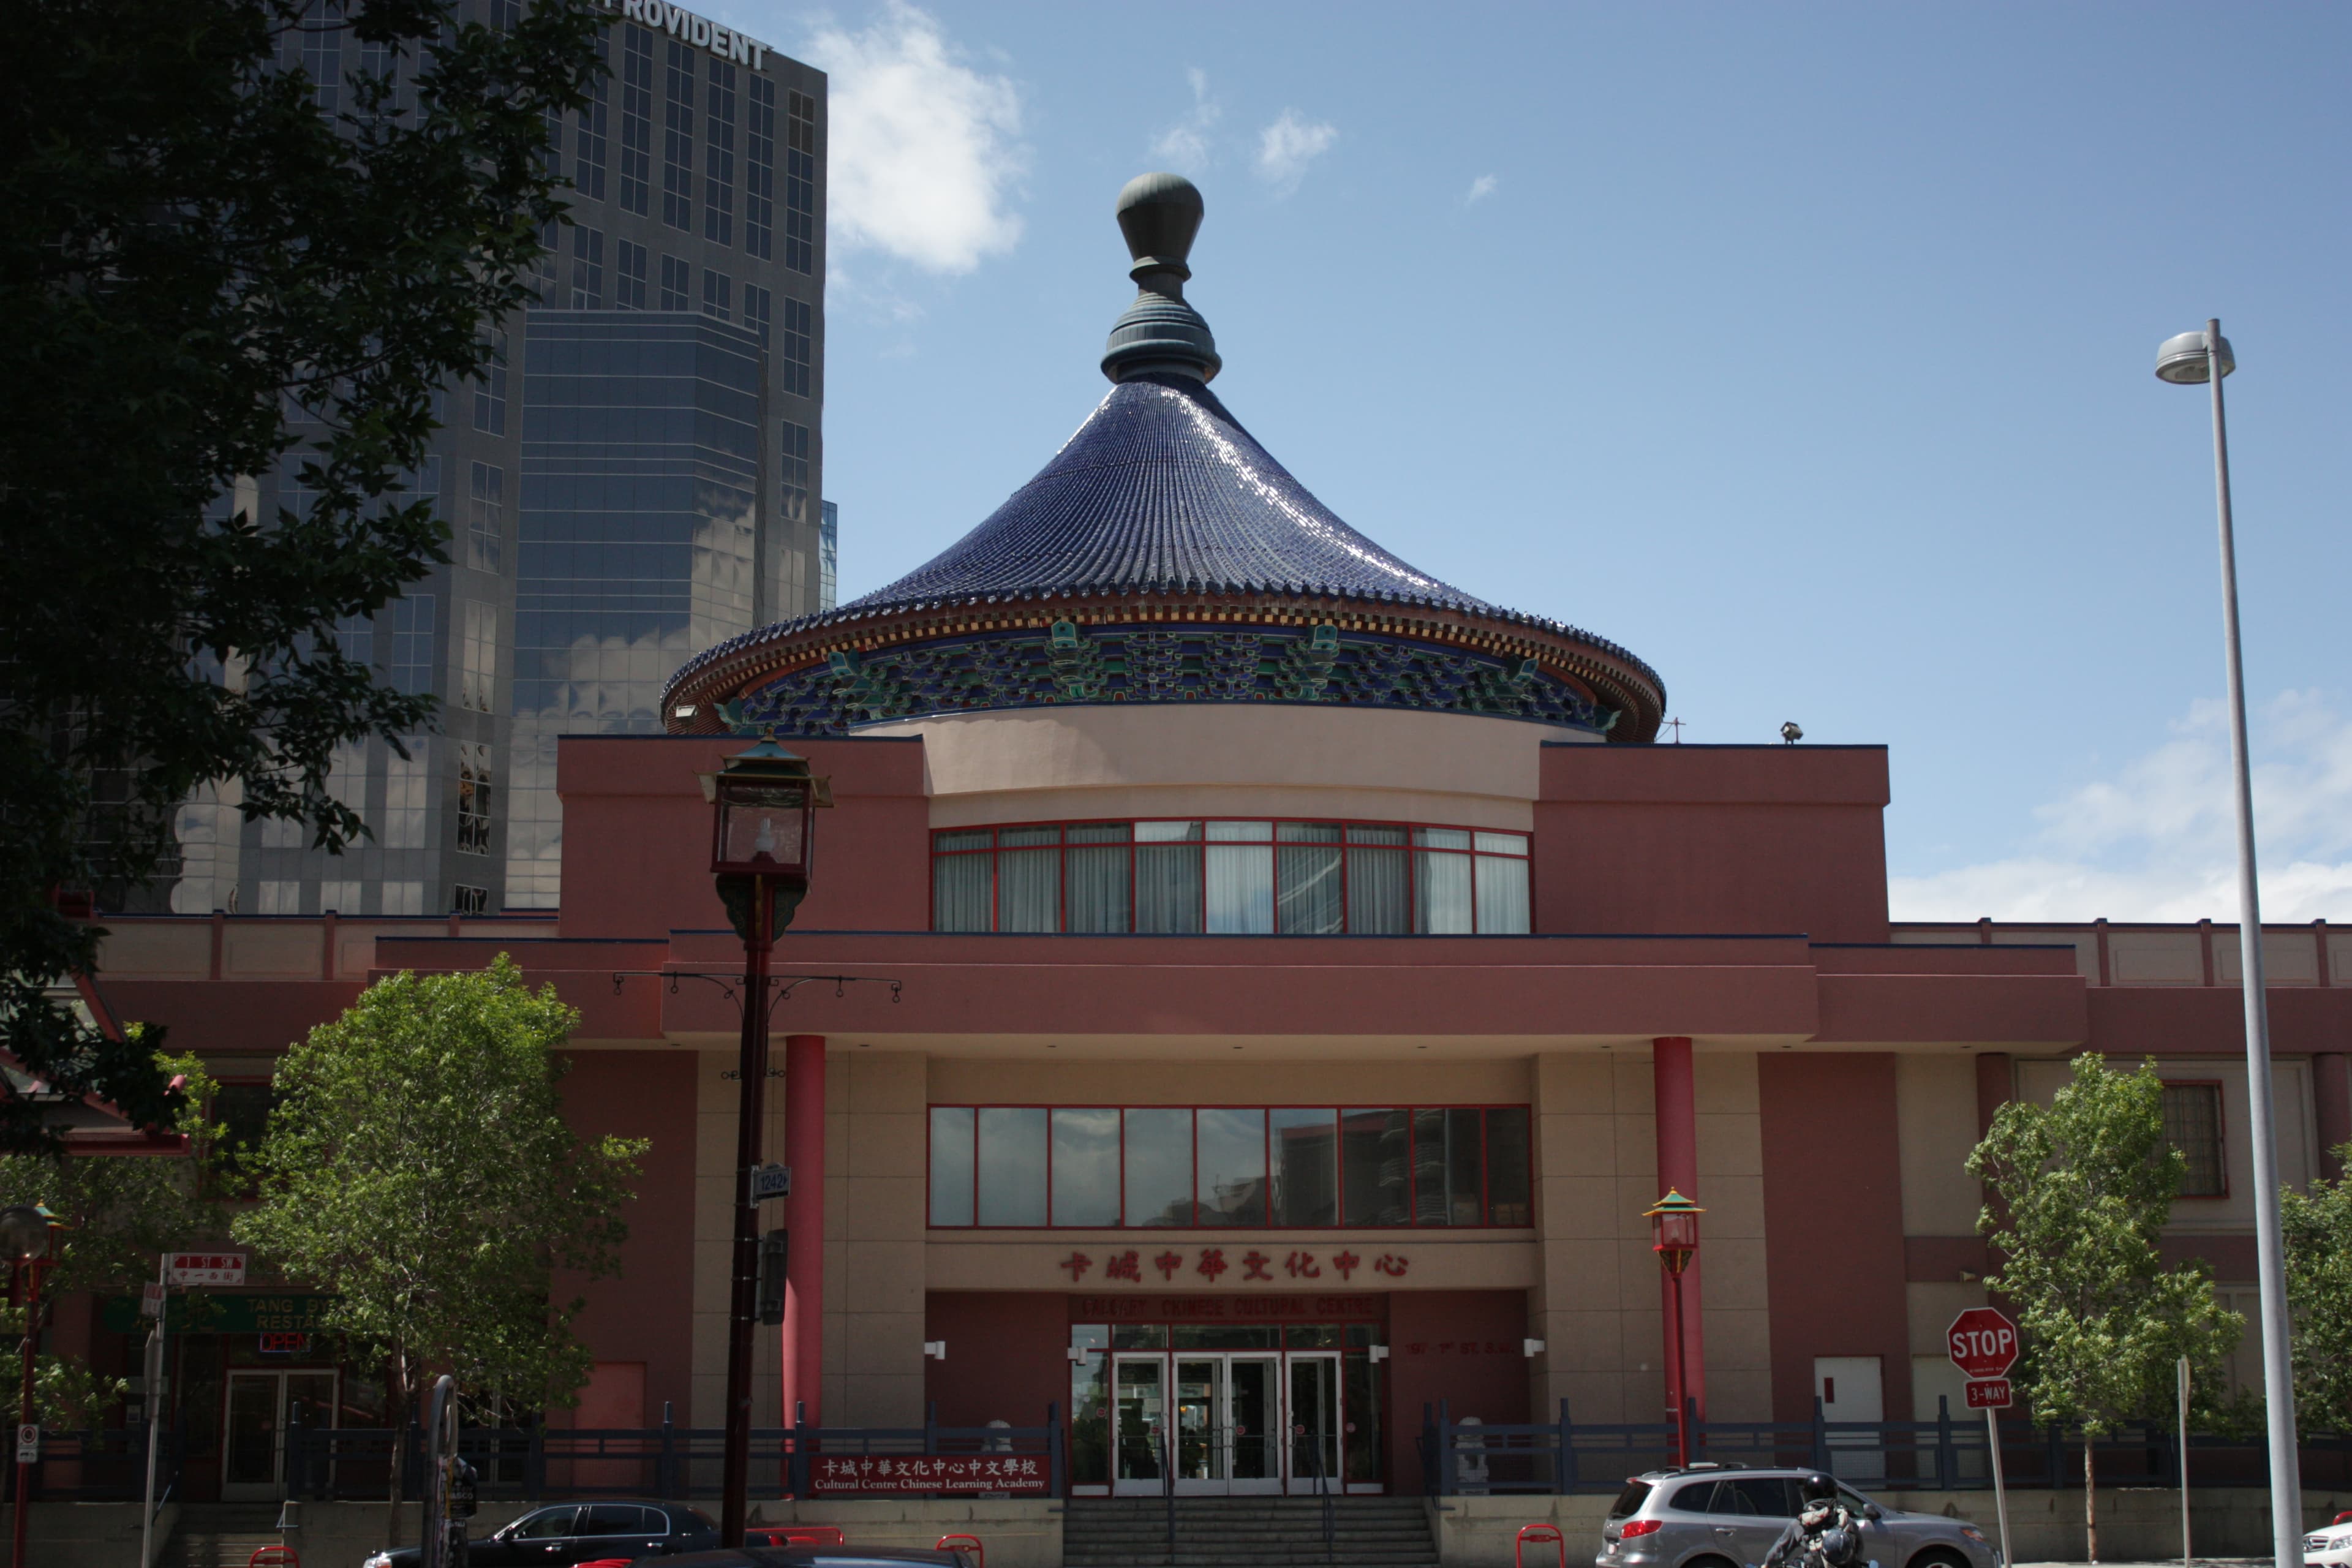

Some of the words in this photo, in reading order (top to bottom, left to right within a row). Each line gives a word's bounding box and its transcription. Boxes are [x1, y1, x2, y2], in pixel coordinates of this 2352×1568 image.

[603, 0, 767, 70] ROVIDENT
[761, 1173, 783, 1191] 1242
[186, 1257, 190, 1268] 1
[201, 1257, 211, 1268] ST
[221, 1257, 233, 1268] SW
[1060, 1249, 1409, 1282] 卡城中華文化中心
[246, 1298, 293, 1313] TANG
[1082, 1298, 1146, 1316] CALGARY
[1161, 1298, 1224, 1316] CHINESE
[1234, 1298, 1305, 1315] CULTURAL
[1316, 1297, 1373, 1314] CENTRE
[262, 1331, 307, 1350] OPEN
[1952, 1329, 2012, 1359] STOP
[1971, 1386, 2005, 1401] 3-WAY
[822, 1458, 1038, 1477] 卡城中華文化中心中文學校
[815, 1479, 859, 1489] Cultural
[862, 1479, 897, 1489] Centre
[900, 1479, 942, 1489] Chinese
[946, 1478, 992, 1490] Learning
[995, 1478, 1045, 1489] Academy
